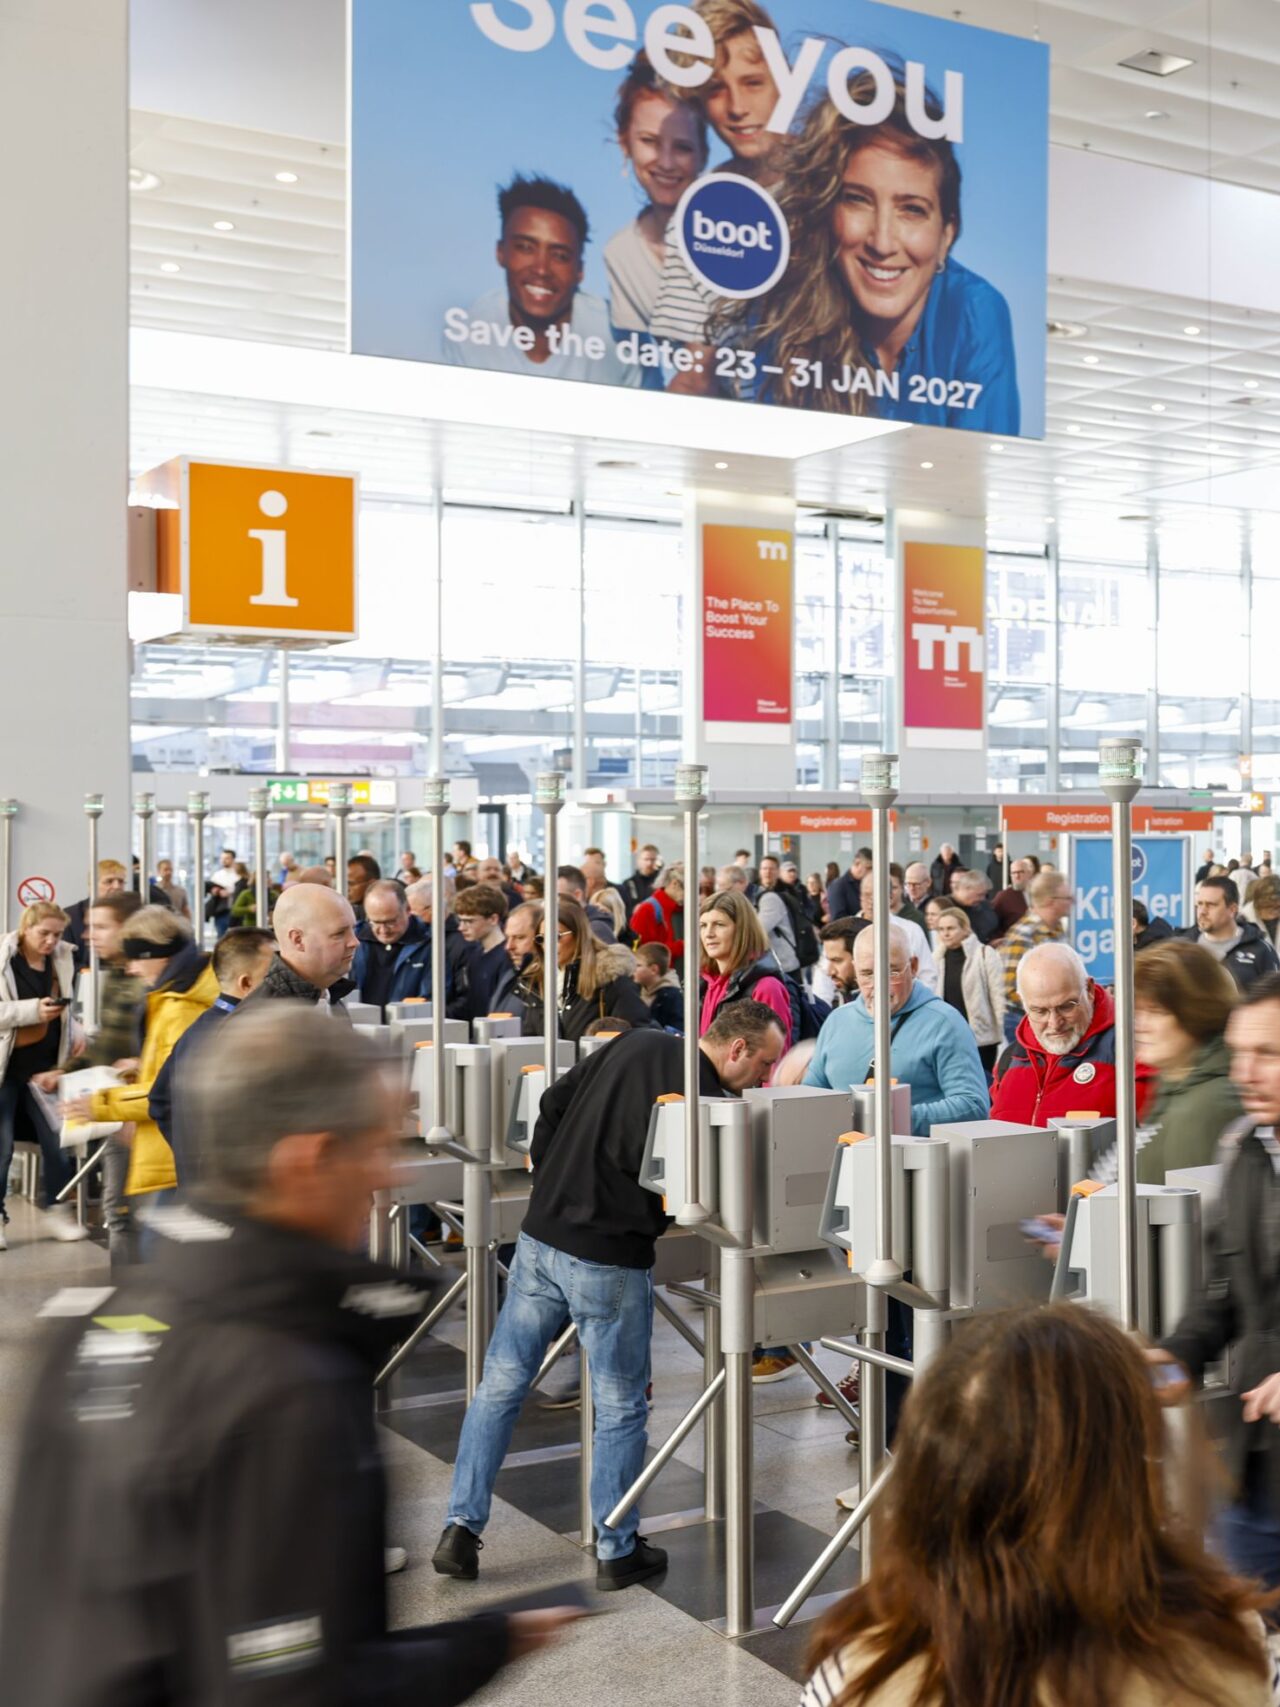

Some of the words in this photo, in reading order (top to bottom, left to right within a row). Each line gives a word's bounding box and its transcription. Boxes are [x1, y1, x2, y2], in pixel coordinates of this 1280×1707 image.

[754, 25, 964, 144] you
[693, 209, 773, 251] boot
[693, 241, 745, 259] Düsseldorf
[444, 308, 535, 351] Save
[545, 323, 606, 361] the
[615, 331, 705, 374] date:
[715, 347, 757, 381] 23
[791, 357, 825, 390] 31
[832, 364, 901, 401] JAN
[908, 376, 983, 410] 2027
[248, 490, 299, 607] i
[706, 596, 729, 609] The
[731, 598, 762, 612] Place
[765, 600, 780, 613] To
[912, 606, 957, 617] Opportunities
[706, 610, 740, 624] Boost
[742, 613, 768, 626] Your
[706, 626, 755, 640] Success
[800, 815, 857, 828] Registration
[1046, 812, 1110, 827] Registration
